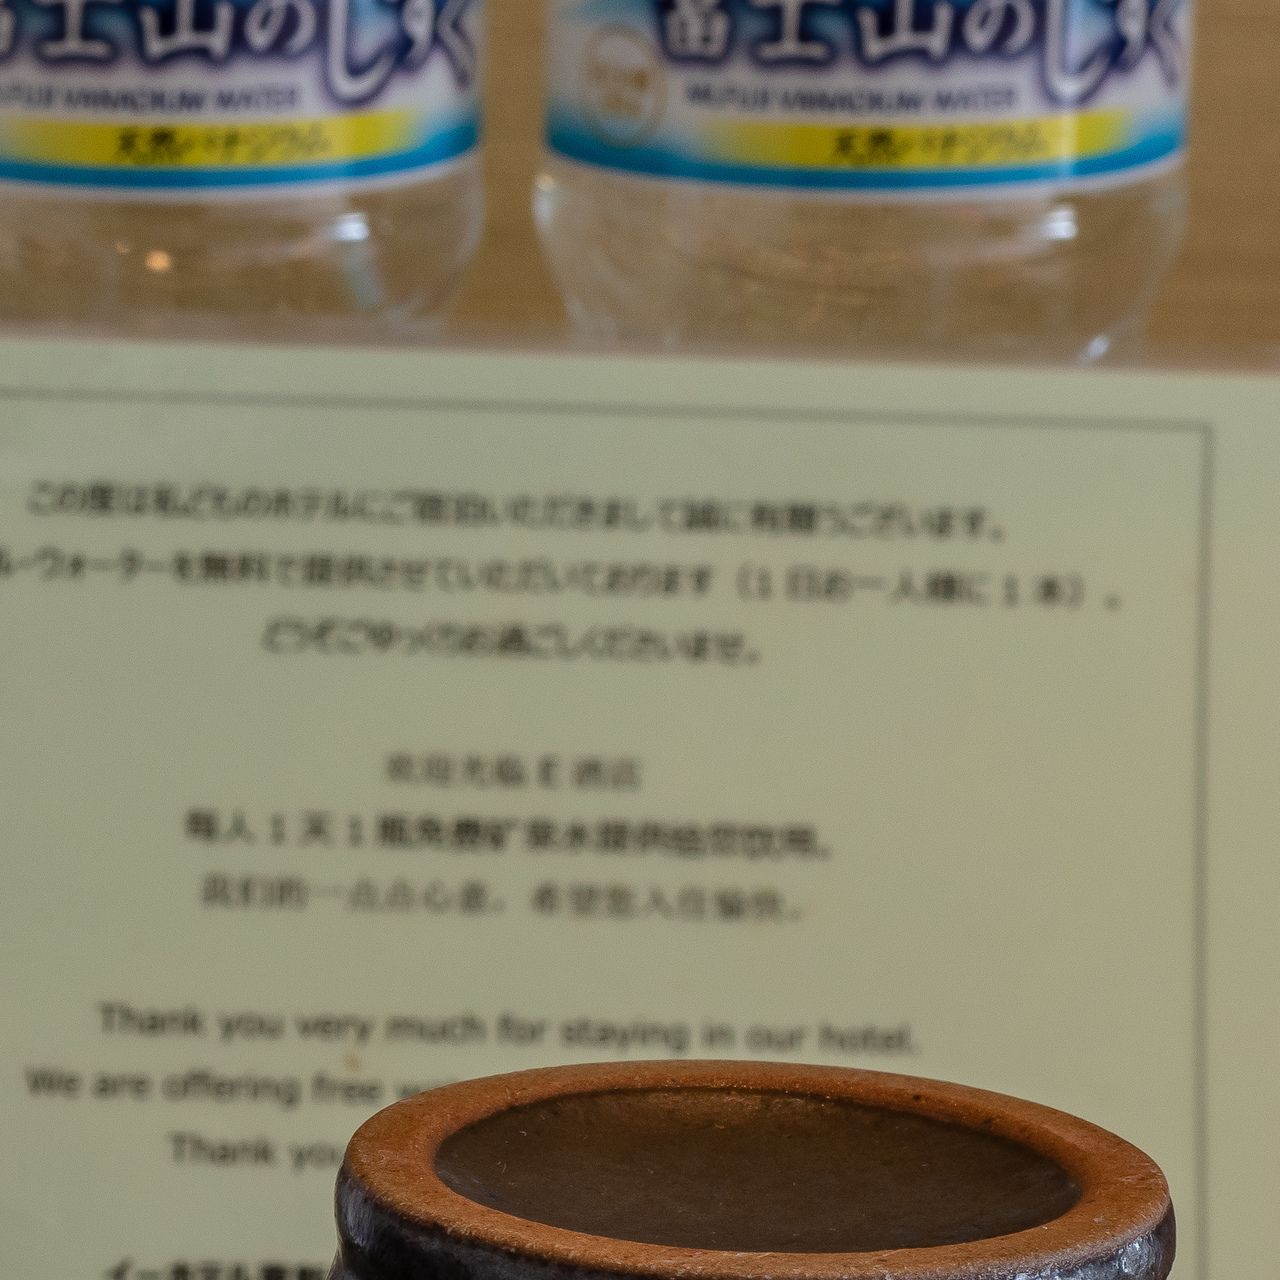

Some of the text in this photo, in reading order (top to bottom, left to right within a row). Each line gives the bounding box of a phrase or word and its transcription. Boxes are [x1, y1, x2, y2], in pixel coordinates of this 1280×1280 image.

[98, 1002, 203, 1036] Thank
[217, 1012, 284, 1042] you
[295, 1014, 370, 1044] very
[385, 1012, 487, 1044] much
[497, 1010, 546, 1046] for
[559, 1015, 690, 1055] staying
[702, 1017, 736, 1051] in
[745, 1023, 807, 1052] our
[25, 1067, 81, 1098] We
[92, 1074, 151, 1099] are
[162, 1068, 302, 1110] offering
[311, 1070, 383, 1102] free
[170, 1132, 275, 1167] Thank
